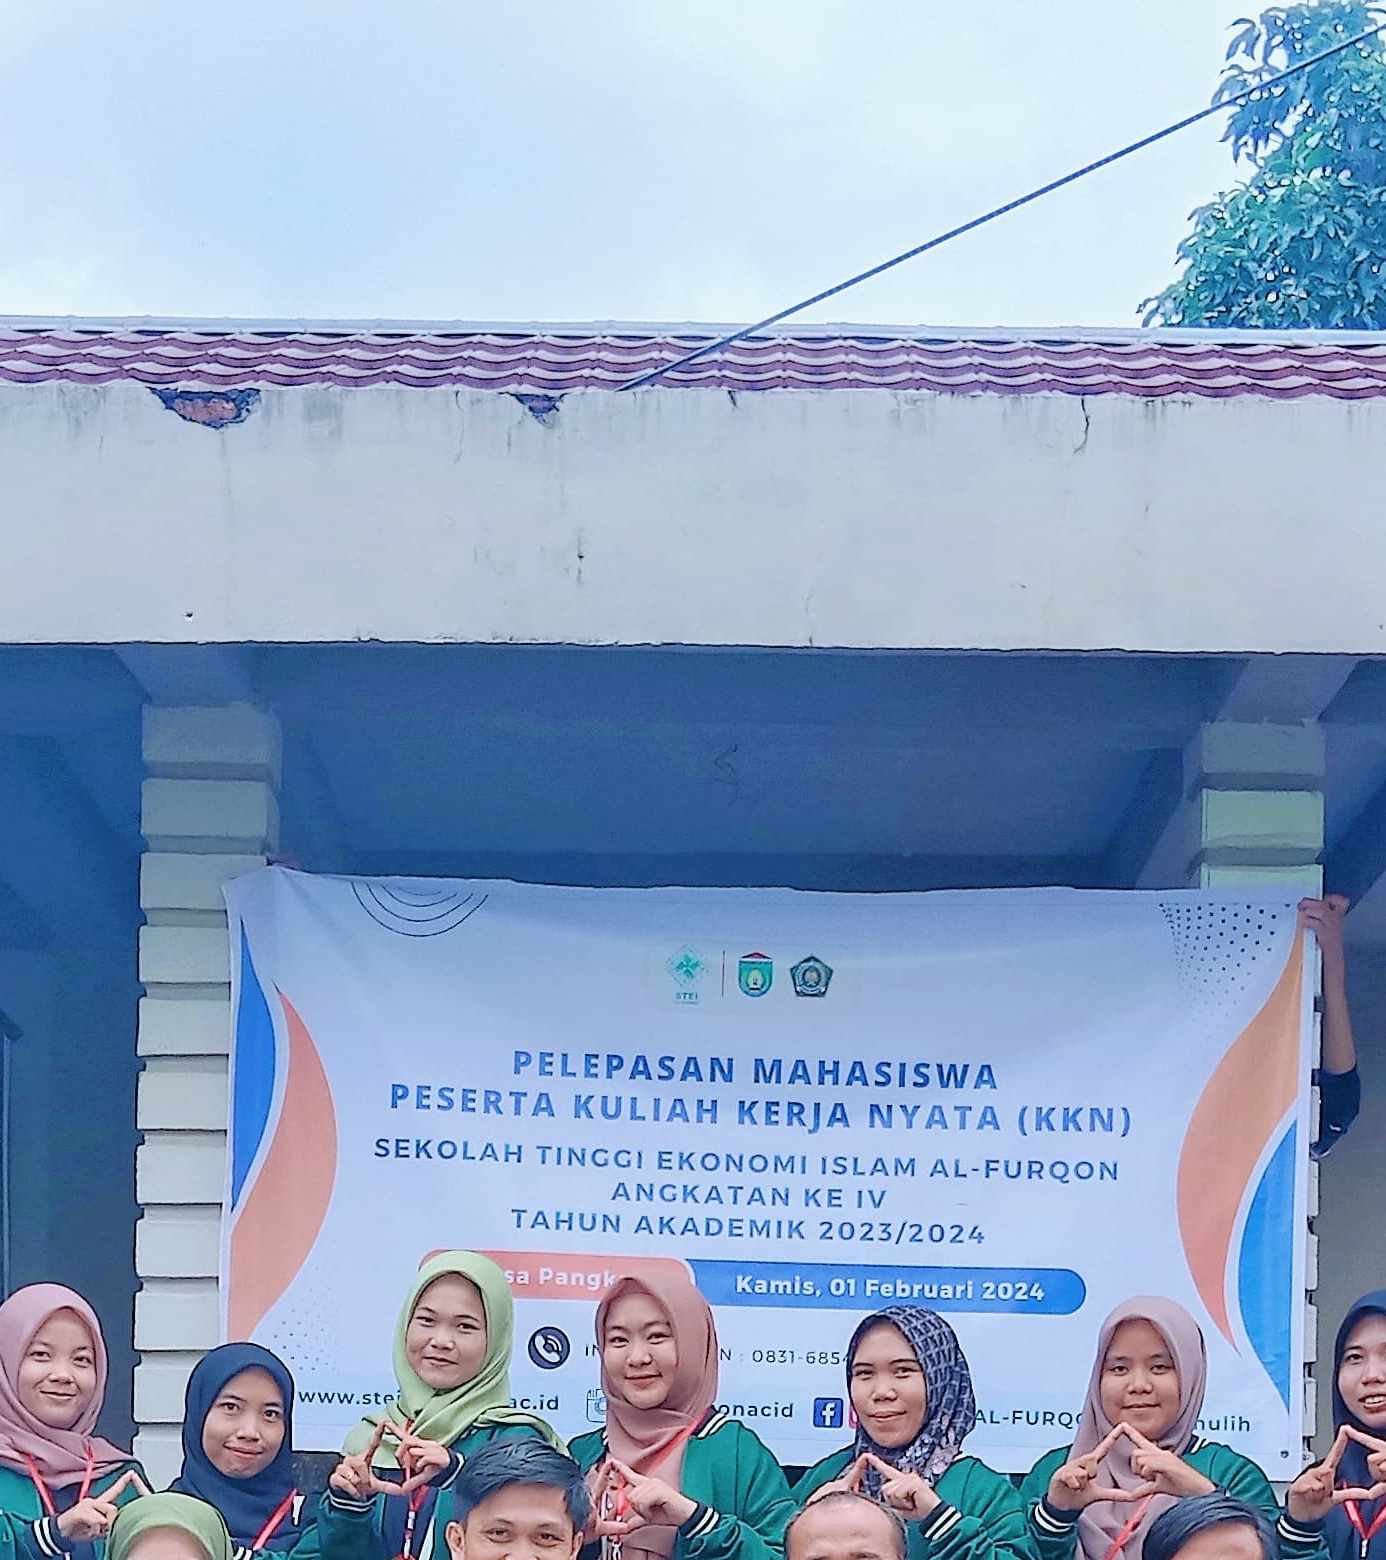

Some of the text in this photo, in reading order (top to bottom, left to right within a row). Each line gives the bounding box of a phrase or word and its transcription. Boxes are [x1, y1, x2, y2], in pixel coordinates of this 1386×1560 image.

[513, 1050, 998, 1090] PELEPASAN MAHASISWA
[390, 1083, 1132, 1138] PESERTA KULIAH KERJA NYATA (KKN)
[374, 1138, 1118, 1184] SEKOLAH TINGGI EKONOMI ISLAM AL-FURQON
[611, 1181, 887, 1208] ANGKATAN KE IV
[512, 1209, 985, 1244] TAHUN AKADEMIK 2023/2024
[539, 1267, 619, 1291] Pangk
[735, 1274, 1045, 1302] Kamis, 01 Februari 2024
[752, 1349, 847, 1365] 0831-685
[974, 1409, 1083, 1430] AL-FURQ
